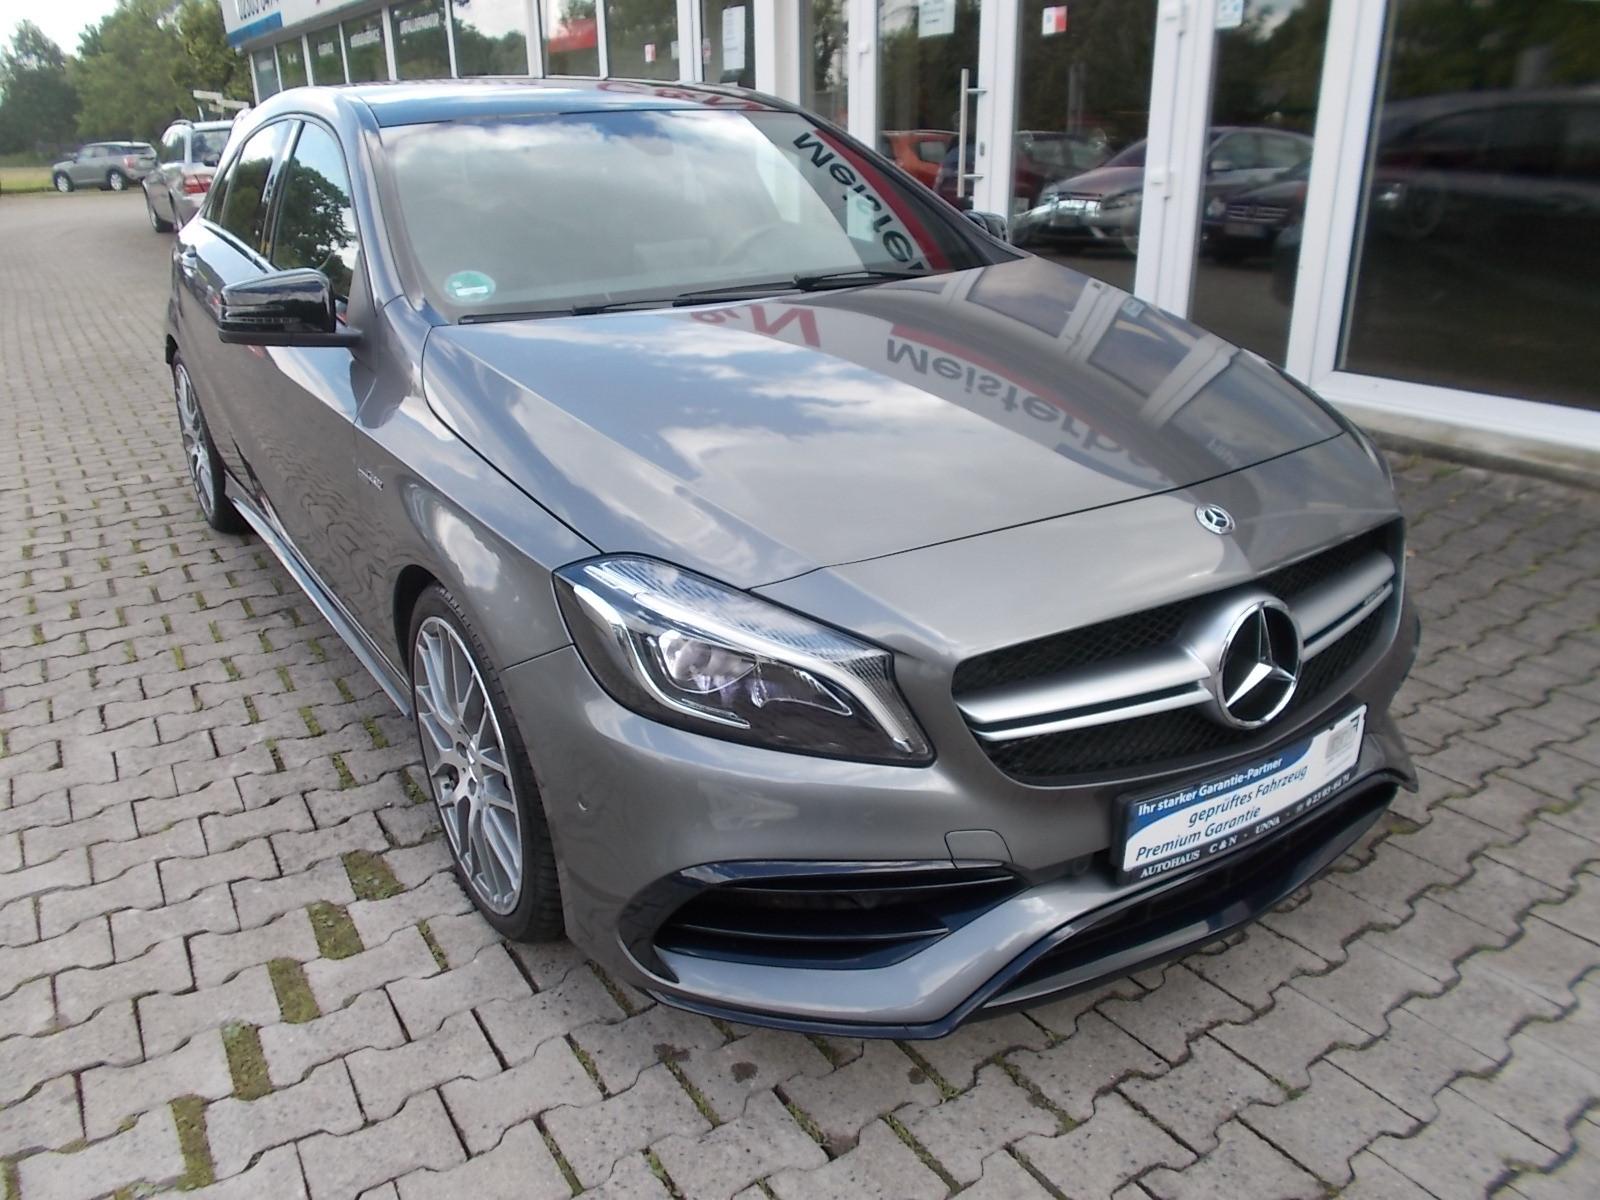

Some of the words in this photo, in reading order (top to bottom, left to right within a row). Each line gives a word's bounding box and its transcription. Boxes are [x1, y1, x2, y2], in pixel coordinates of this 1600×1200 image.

[1138, 802, 1156, 816] Ihr
[1157, 789, 1198, 811] starker
[1198, 758, 1283, 797] Garantie-Partner
[1188, 791, 1252, 828] geprüftes
[1255, 765, 1309, 798] Fahrzeug
[1136, 831, 1202, 861] Premium
[1204, 806, 1261, 838] Garantie
[1140, 849, 1201, 879] AUTOHAUS
